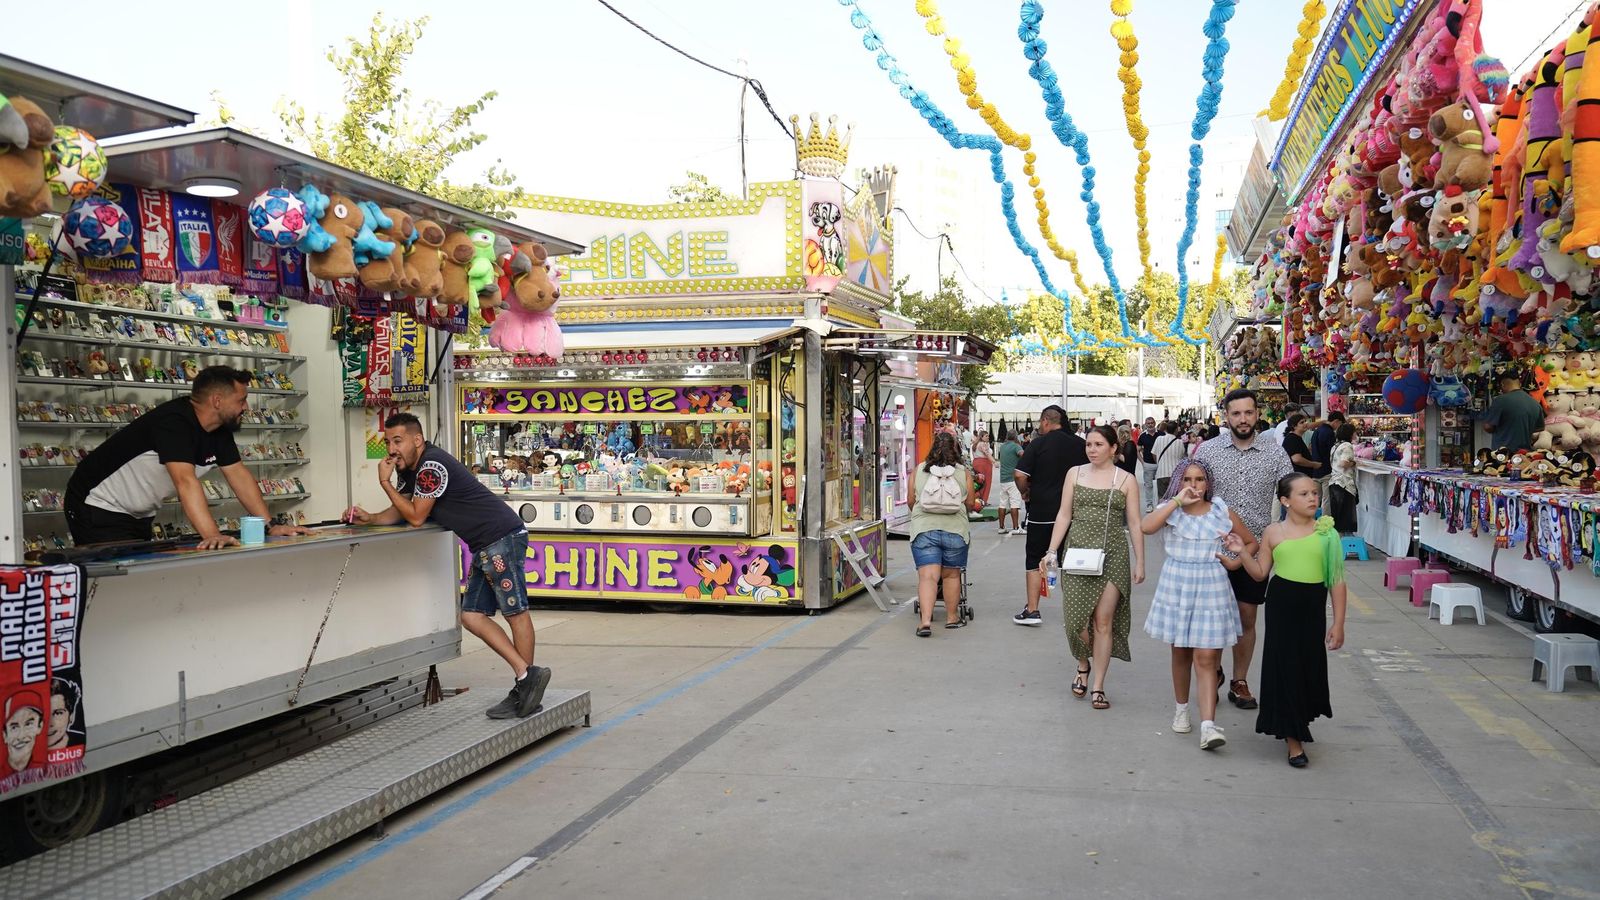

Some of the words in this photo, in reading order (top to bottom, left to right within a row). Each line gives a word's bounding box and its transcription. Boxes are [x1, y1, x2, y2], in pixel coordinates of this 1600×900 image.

[180, 223, 208, 232] ITALIA
[144, 258, 173, 268] SEVILLA
[247, 270, 270, 280] Madrid
[376, 316, 391, 372] SEVILLA
[506, 388, 677, 413] SANCHEZ
[1, 584, 26, 661] MARC
